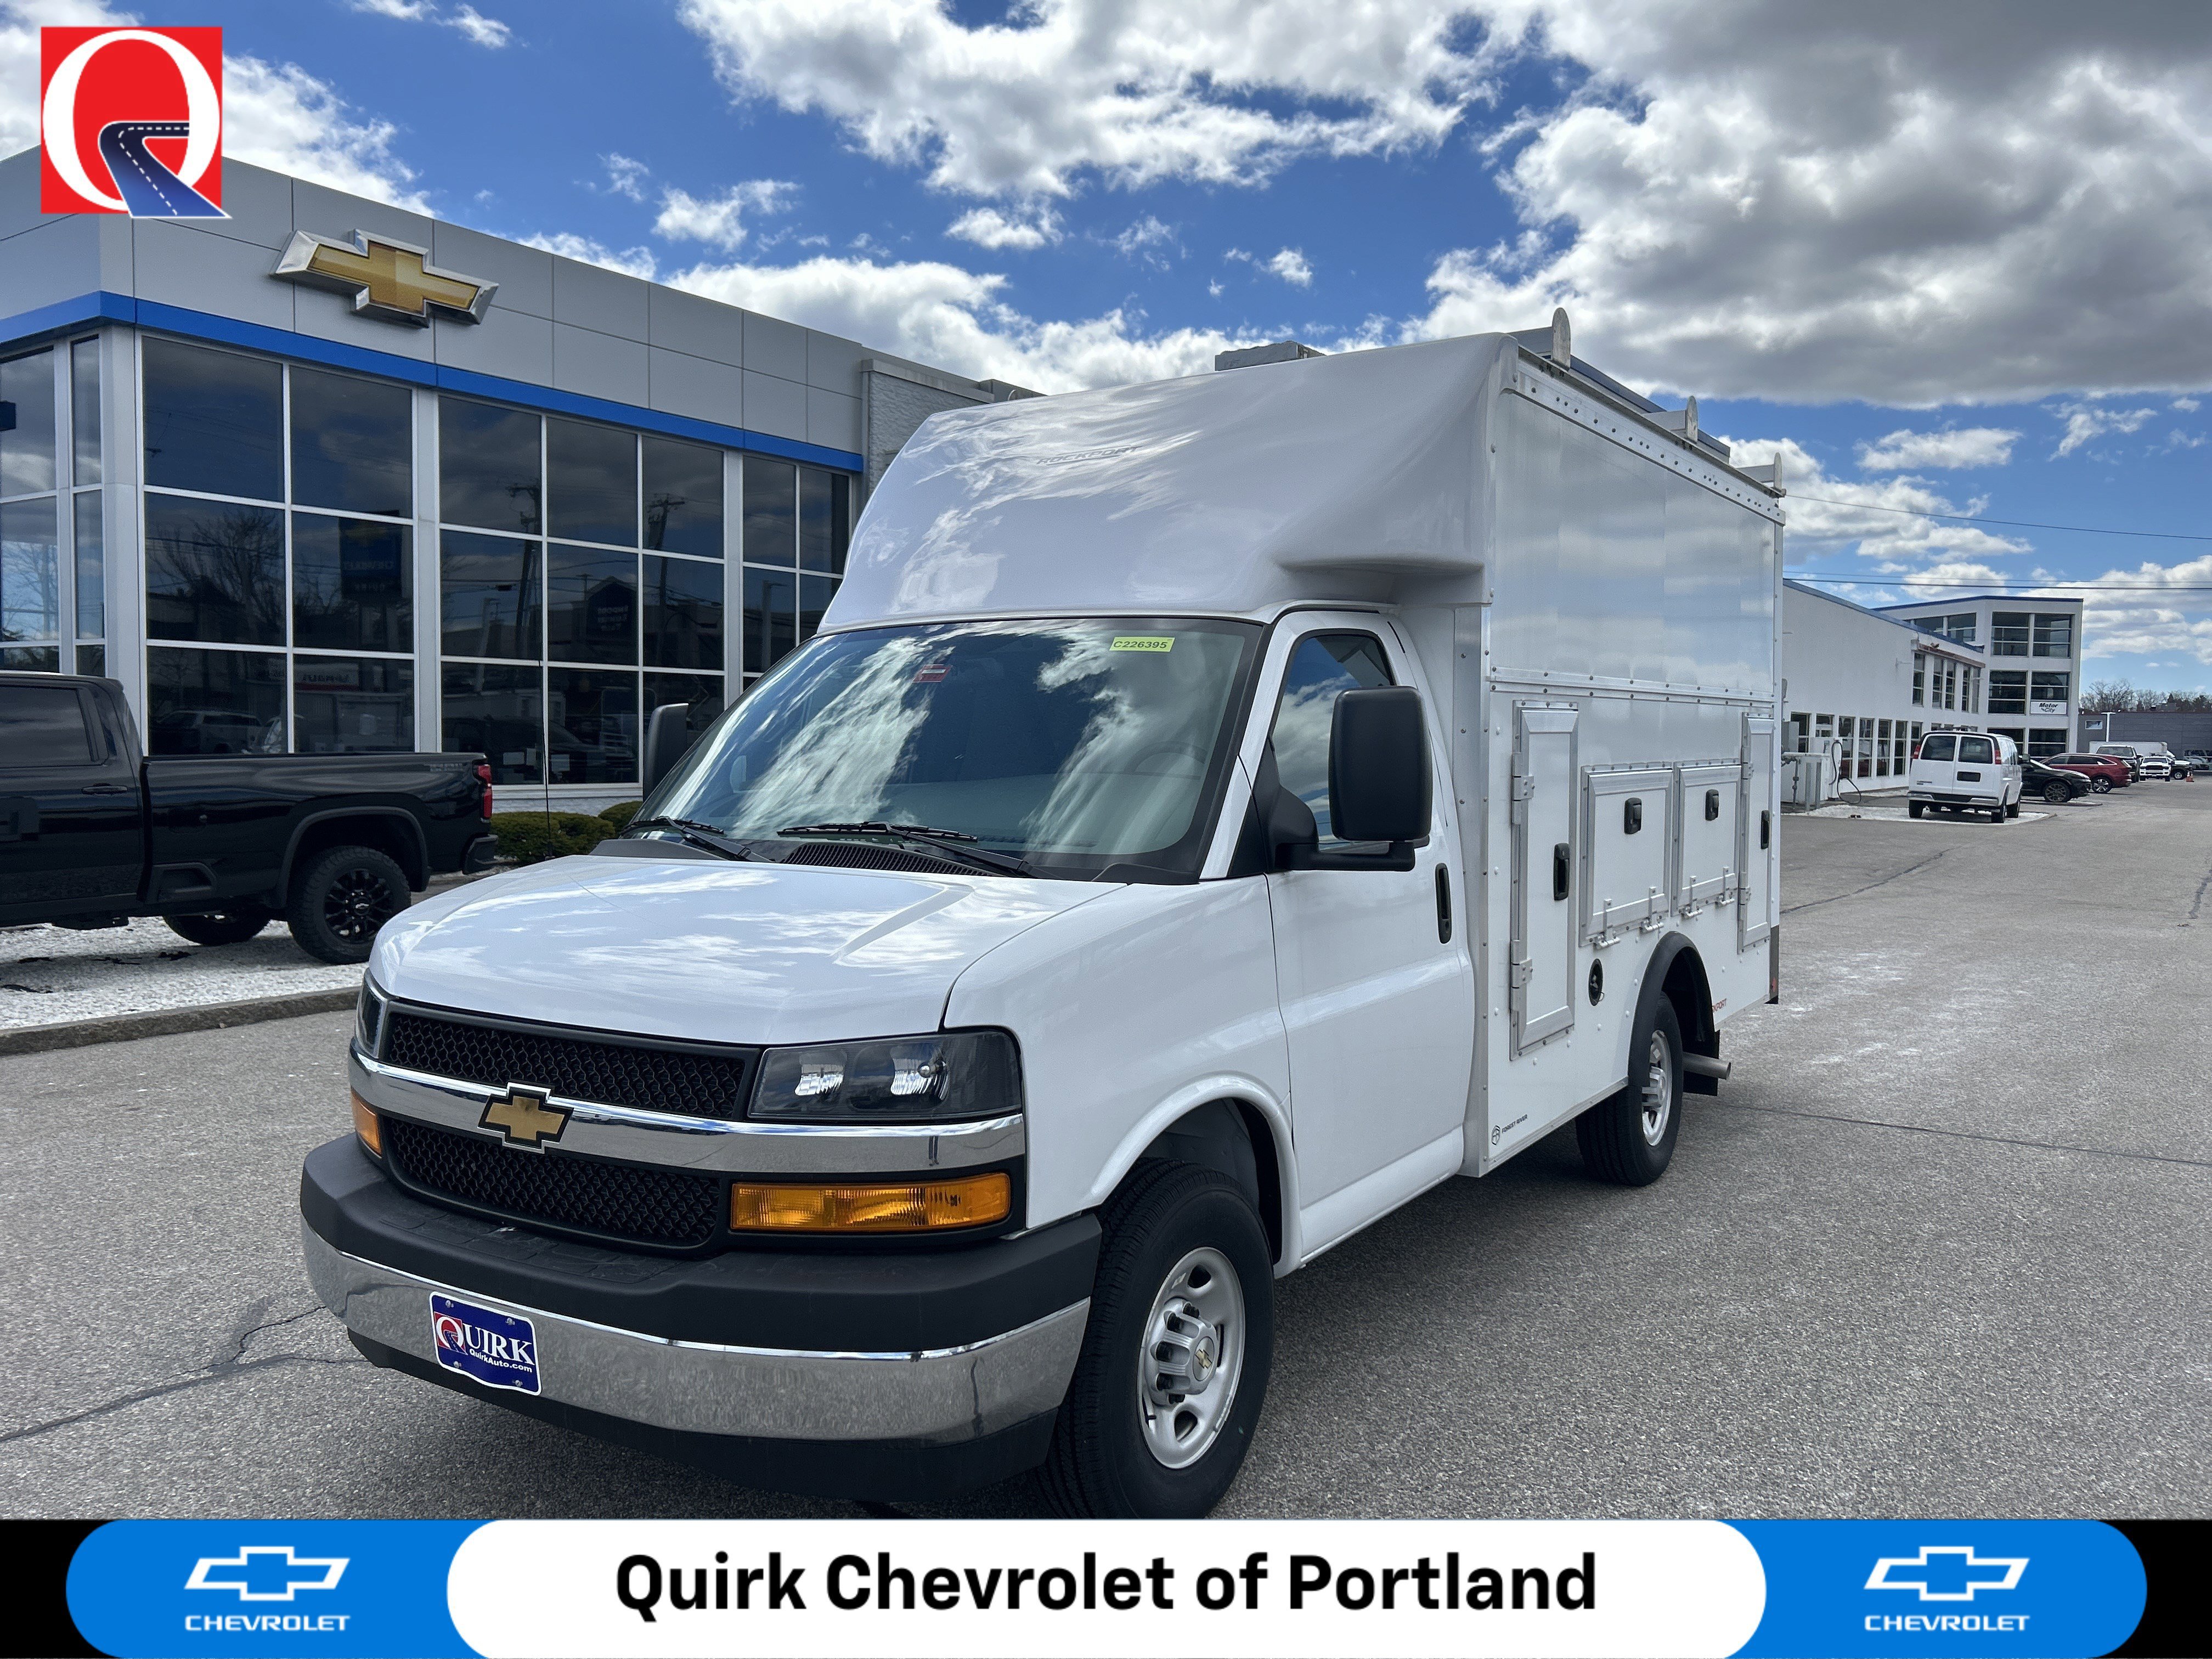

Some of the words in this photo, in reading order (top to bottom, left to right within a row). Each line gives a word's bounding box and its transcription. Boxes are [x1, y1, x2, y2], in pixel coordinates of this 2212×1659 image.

[1036, 445, 1143, 465] ROCKPORT
[1113, 640, 1167, 649] C226395
[436, 1315, 535, 1365] QUIRK
[470, 1348, 533, 1373] QuirkAuto.com
